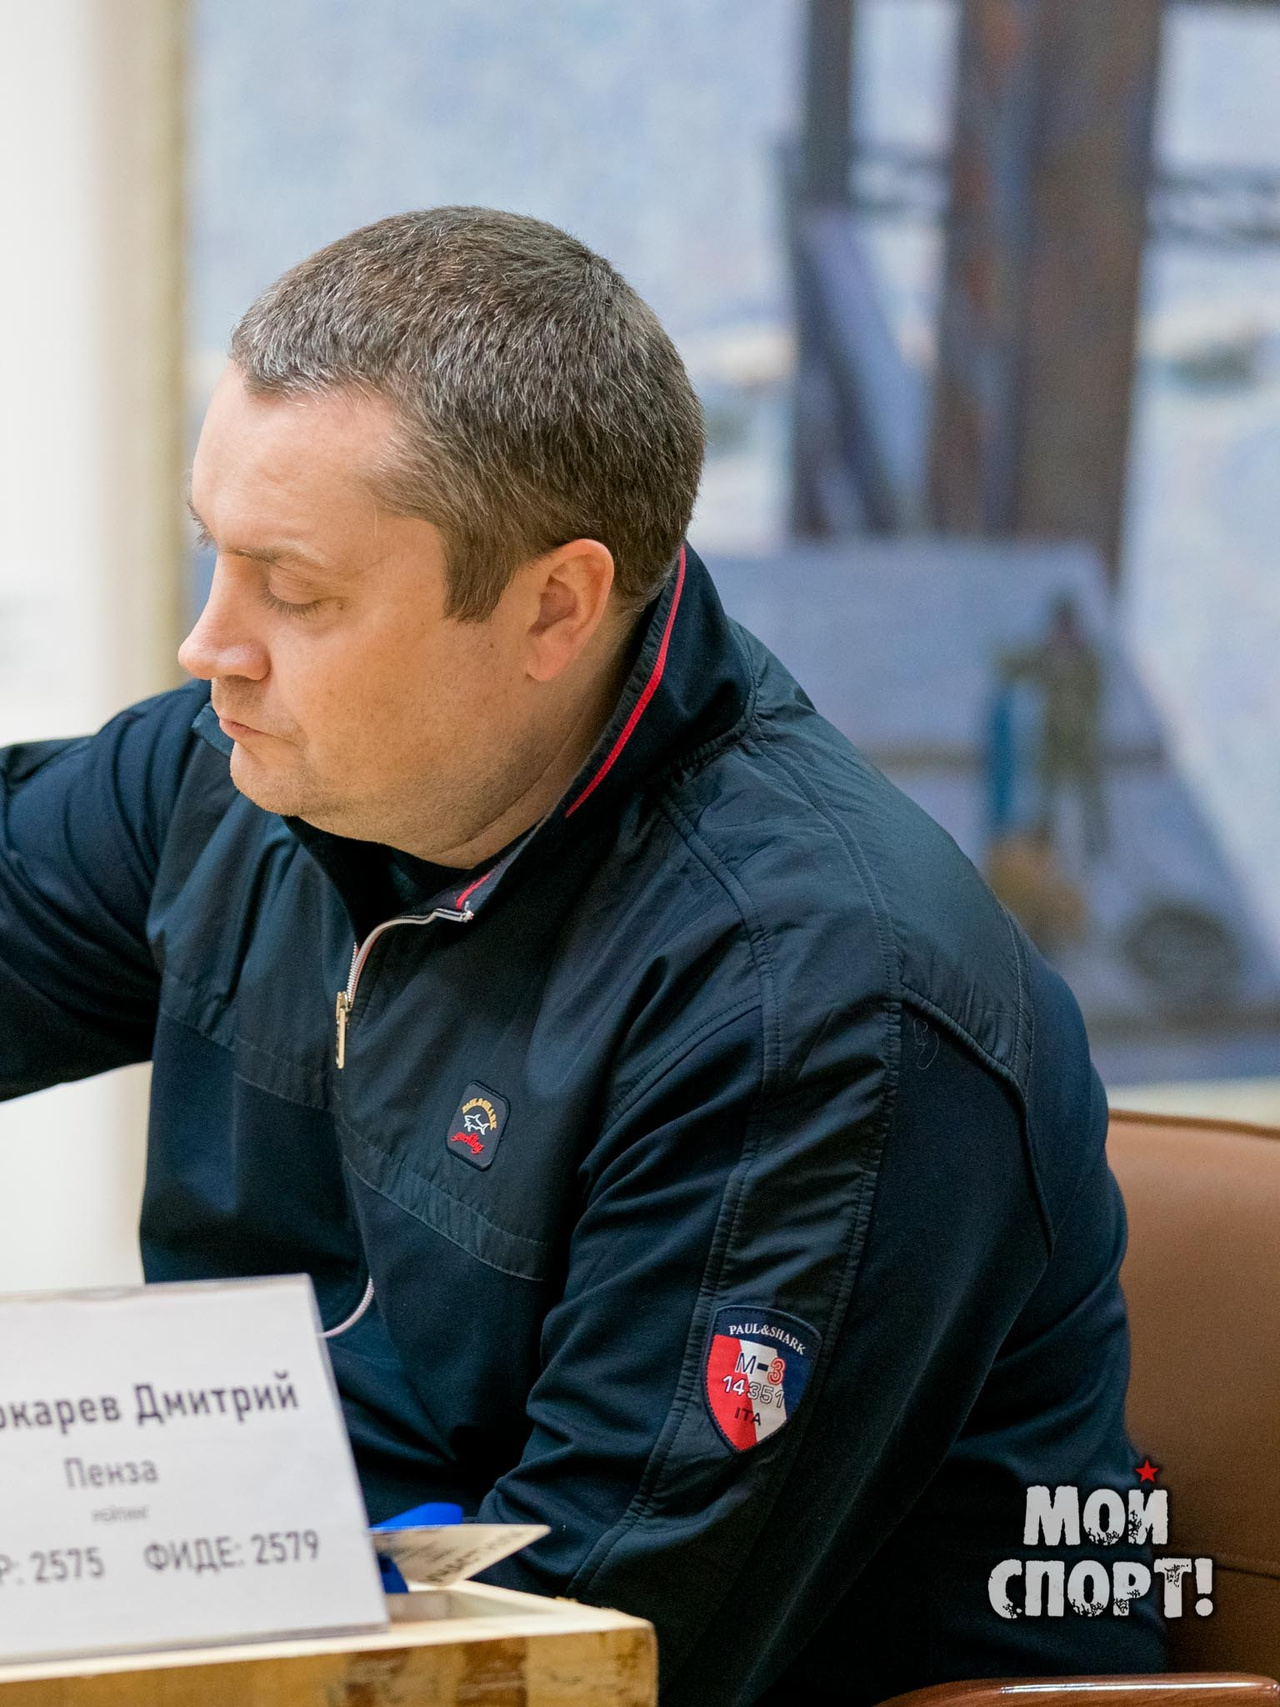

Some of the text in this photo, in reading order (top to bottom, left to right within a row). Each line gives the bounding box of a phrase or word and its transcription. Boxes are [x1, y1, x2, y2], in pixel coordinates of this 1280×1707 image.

[728, 1323, 806, 1355] PAUL&SHARK
[735, 1353, 786, 1385] M-3
[133, 1371, 300, 1427] Дмитрий
[723, 1375, 785, 1408] 14351
[734, 1407, 762, 1426] ITA
[62, 1456, 160, 1490] Пенза
[29, 1546, 107, 1585] 2575
[143, 1535, 246, 1575] ФИДЕ:
[250, 1528, 321, 1566] 2579
